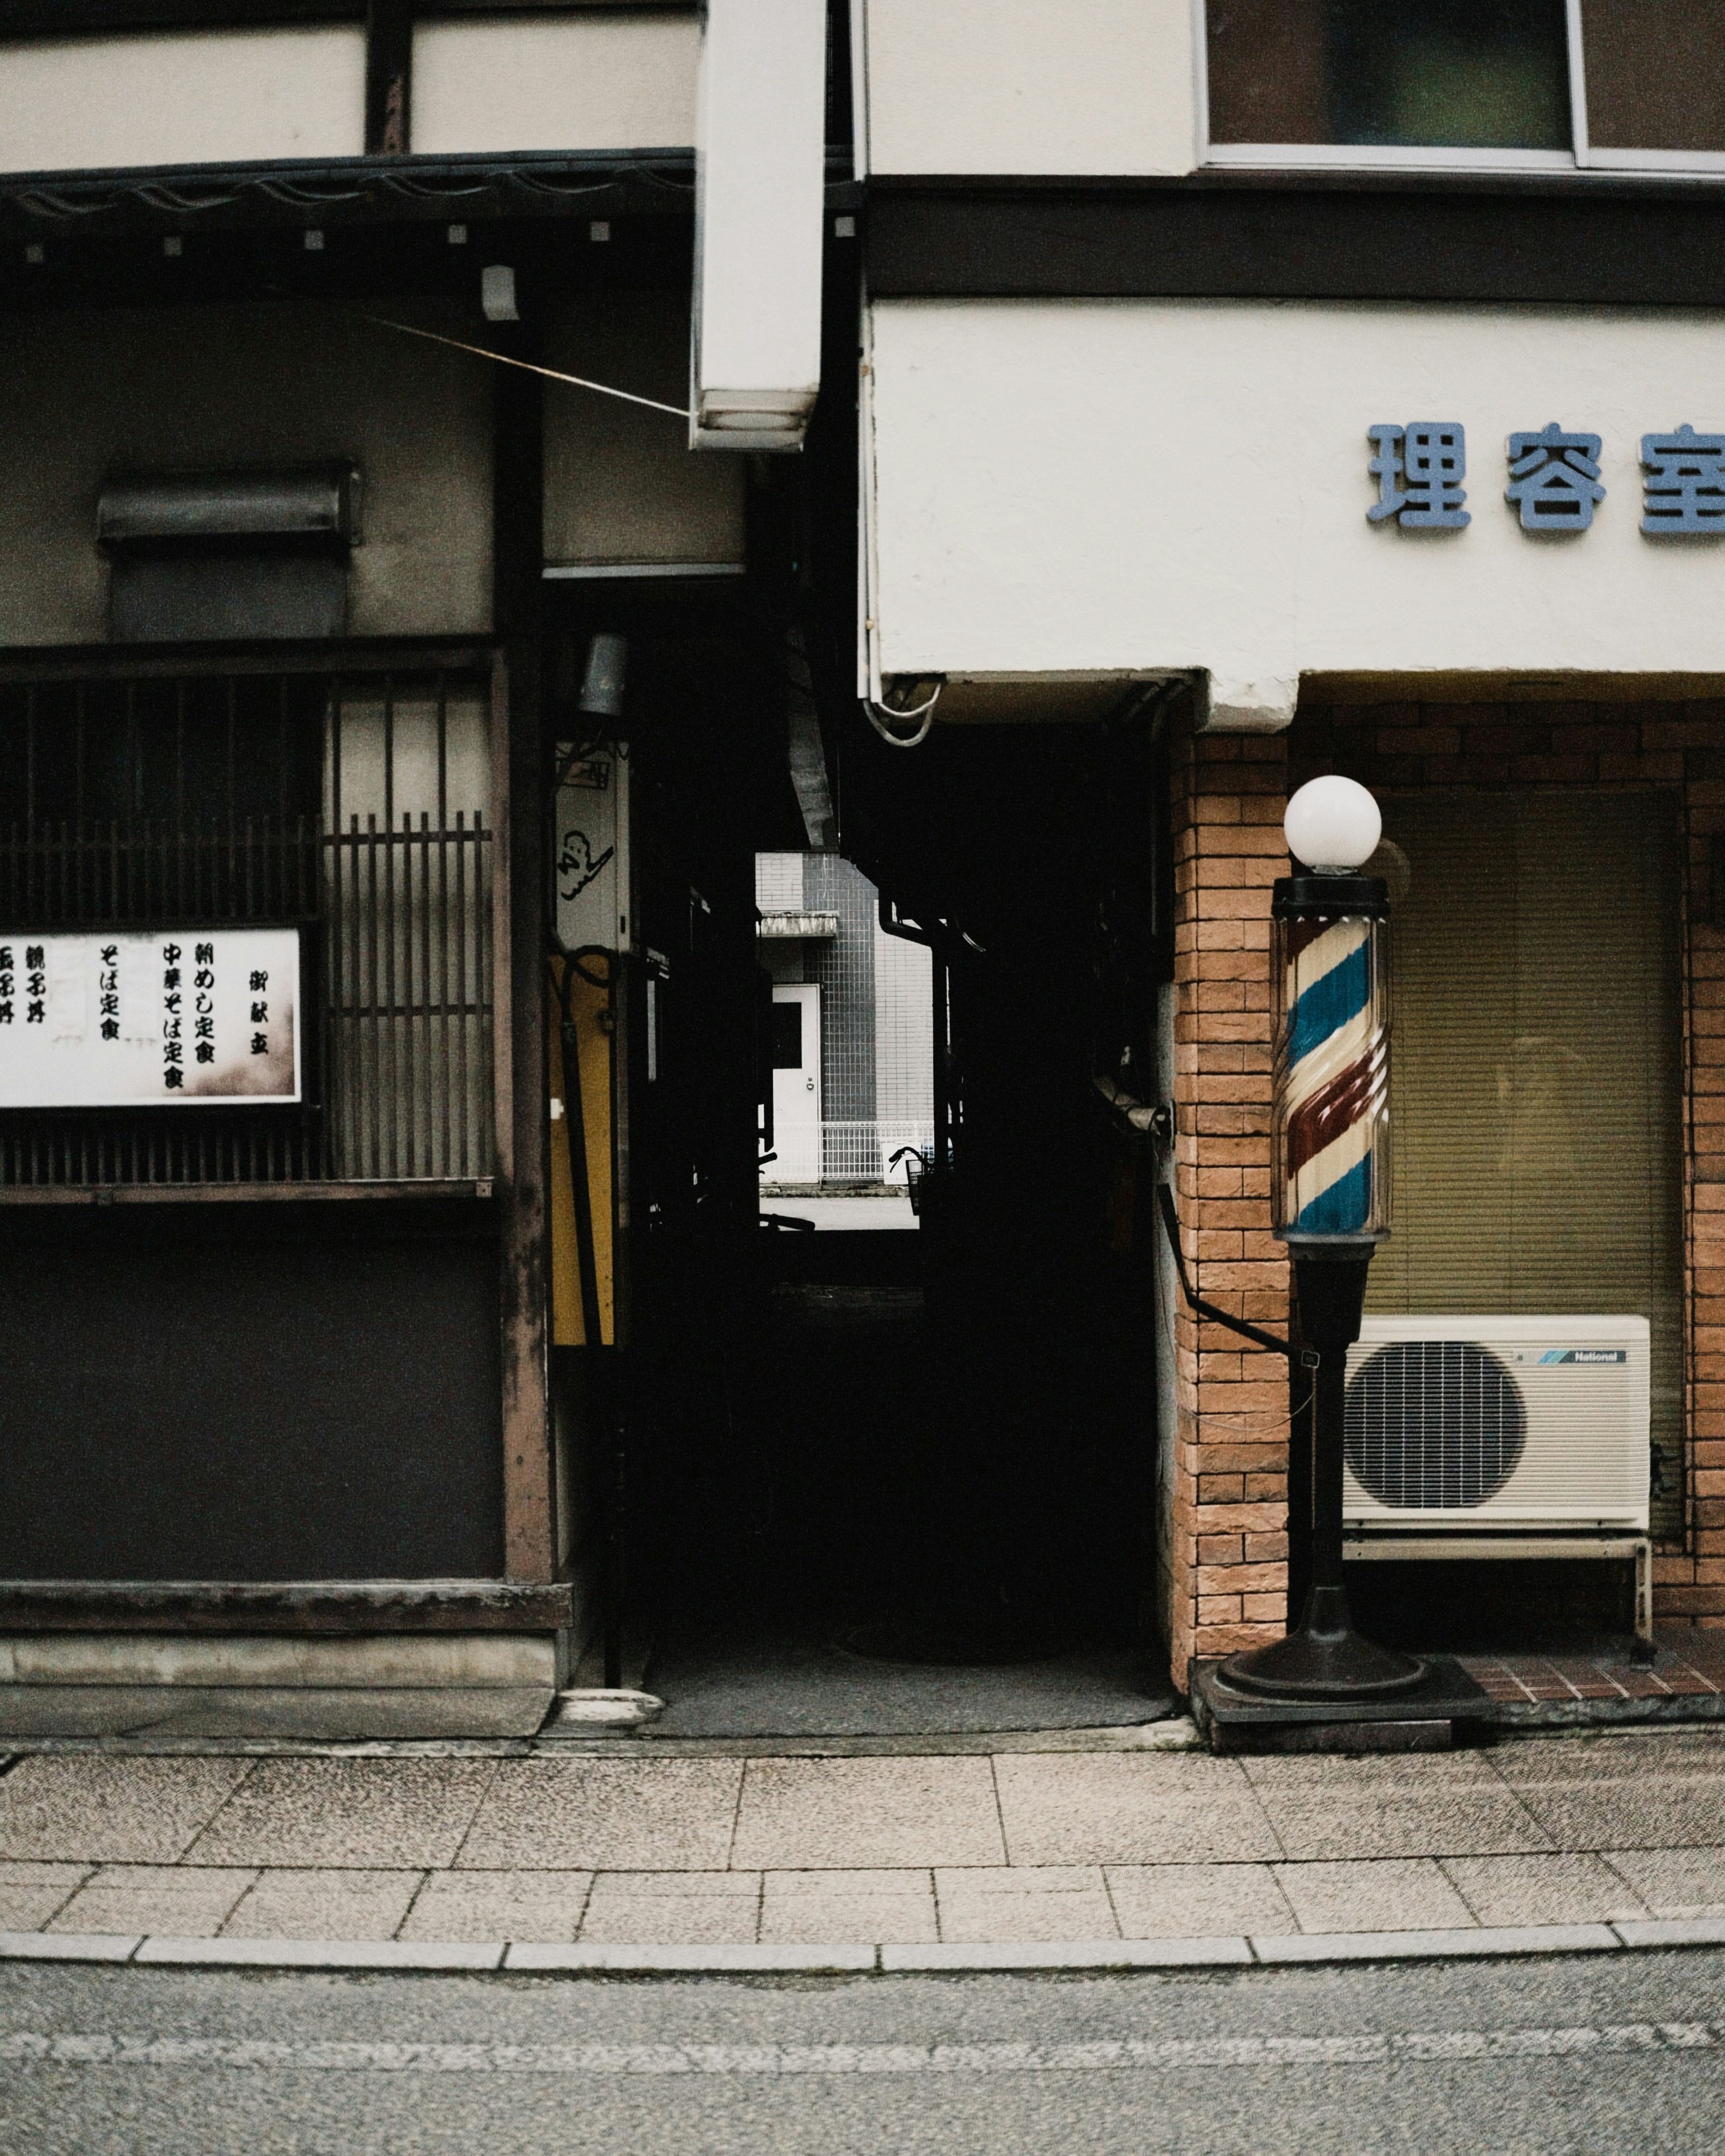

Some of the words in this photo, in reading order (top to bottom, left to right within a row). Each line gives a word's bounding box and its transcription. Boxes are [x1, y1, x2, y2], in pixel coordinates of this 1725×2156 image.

[1367, 422, 1725, 532] 理容室
[26, 945, 46, 1024] 親子丼
[100, 945, 120, 1041] そば定食
[163, 943, 184, 1089] 中華そば定食
[194, 942, 215, 1064] 朝めし定食
[249, 970, 269, 1055] 御献立
[1574, 1351, 1618, 1362] National
